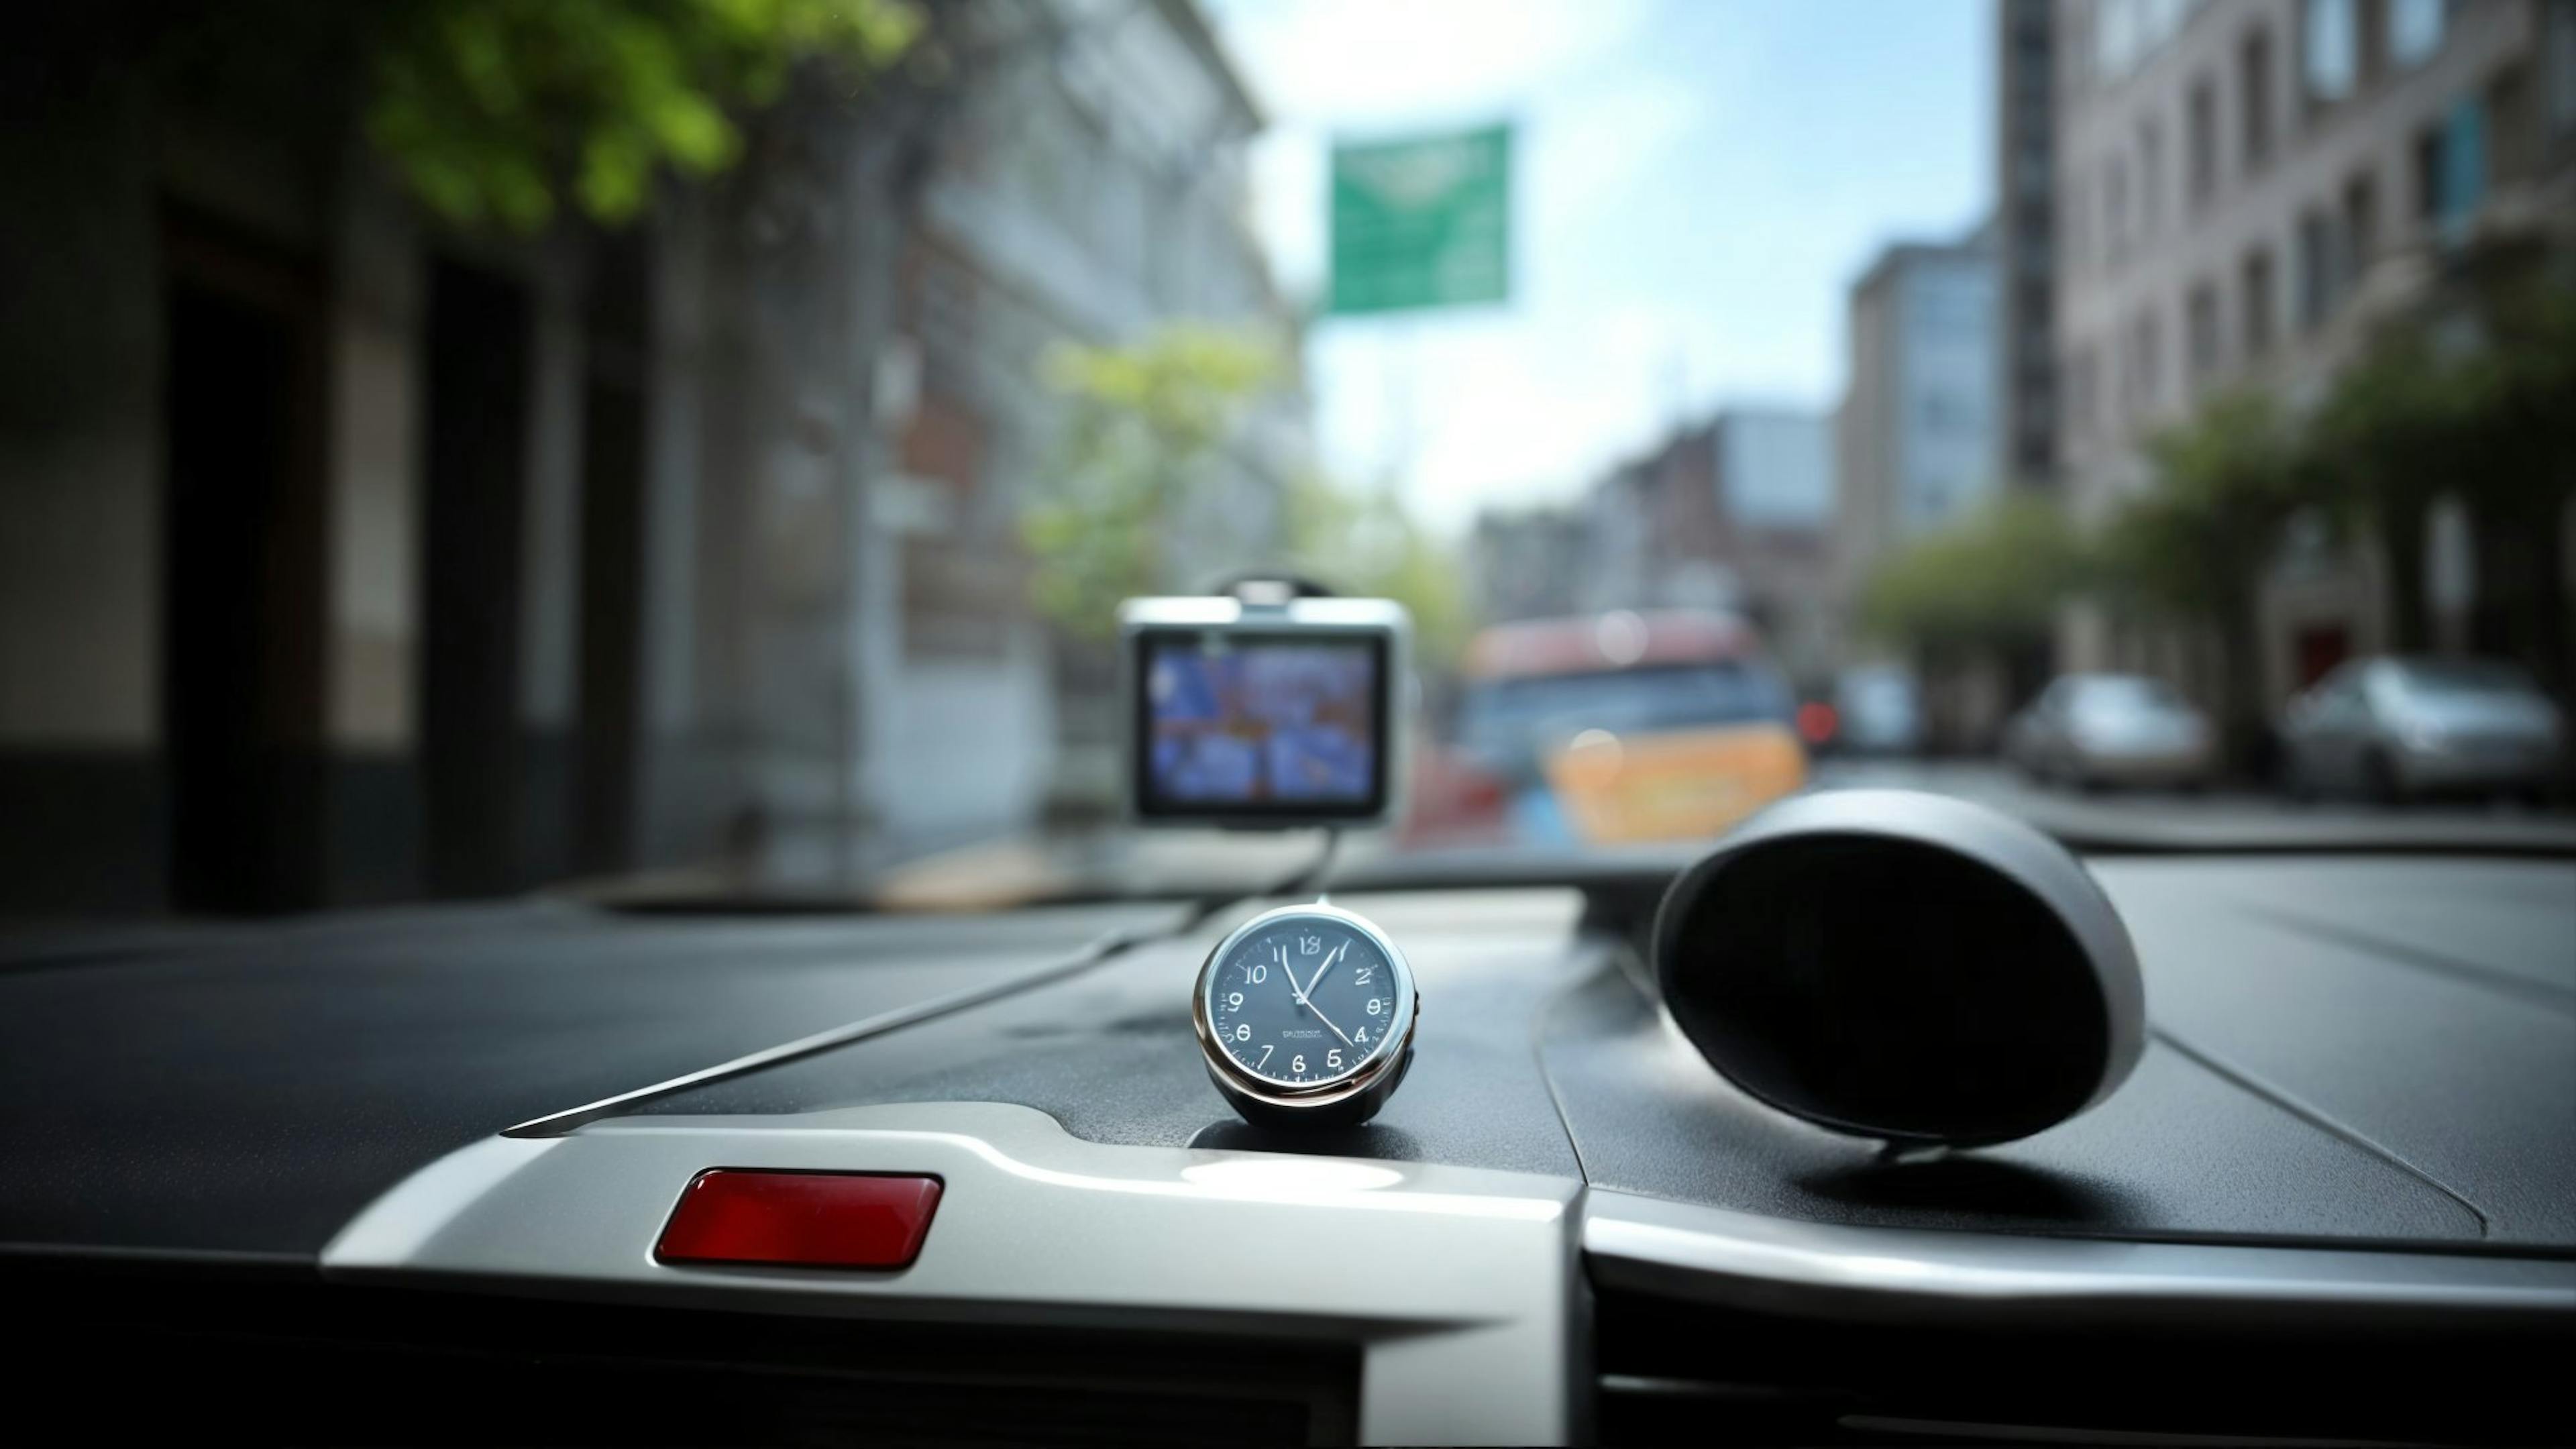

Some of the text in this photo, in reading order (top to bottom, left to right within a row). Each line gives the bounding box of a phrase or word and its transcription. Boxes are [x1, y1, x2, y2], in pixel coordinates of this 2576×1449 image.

[1244, 965, 1267, 984] 10
[1355, 967, 1372, 985] 2
[1256, 1044, 1275, 1070] 7
[1292, 1055, 1307, 1073] 6
[1326, 1049, 1342, 1068] 5
